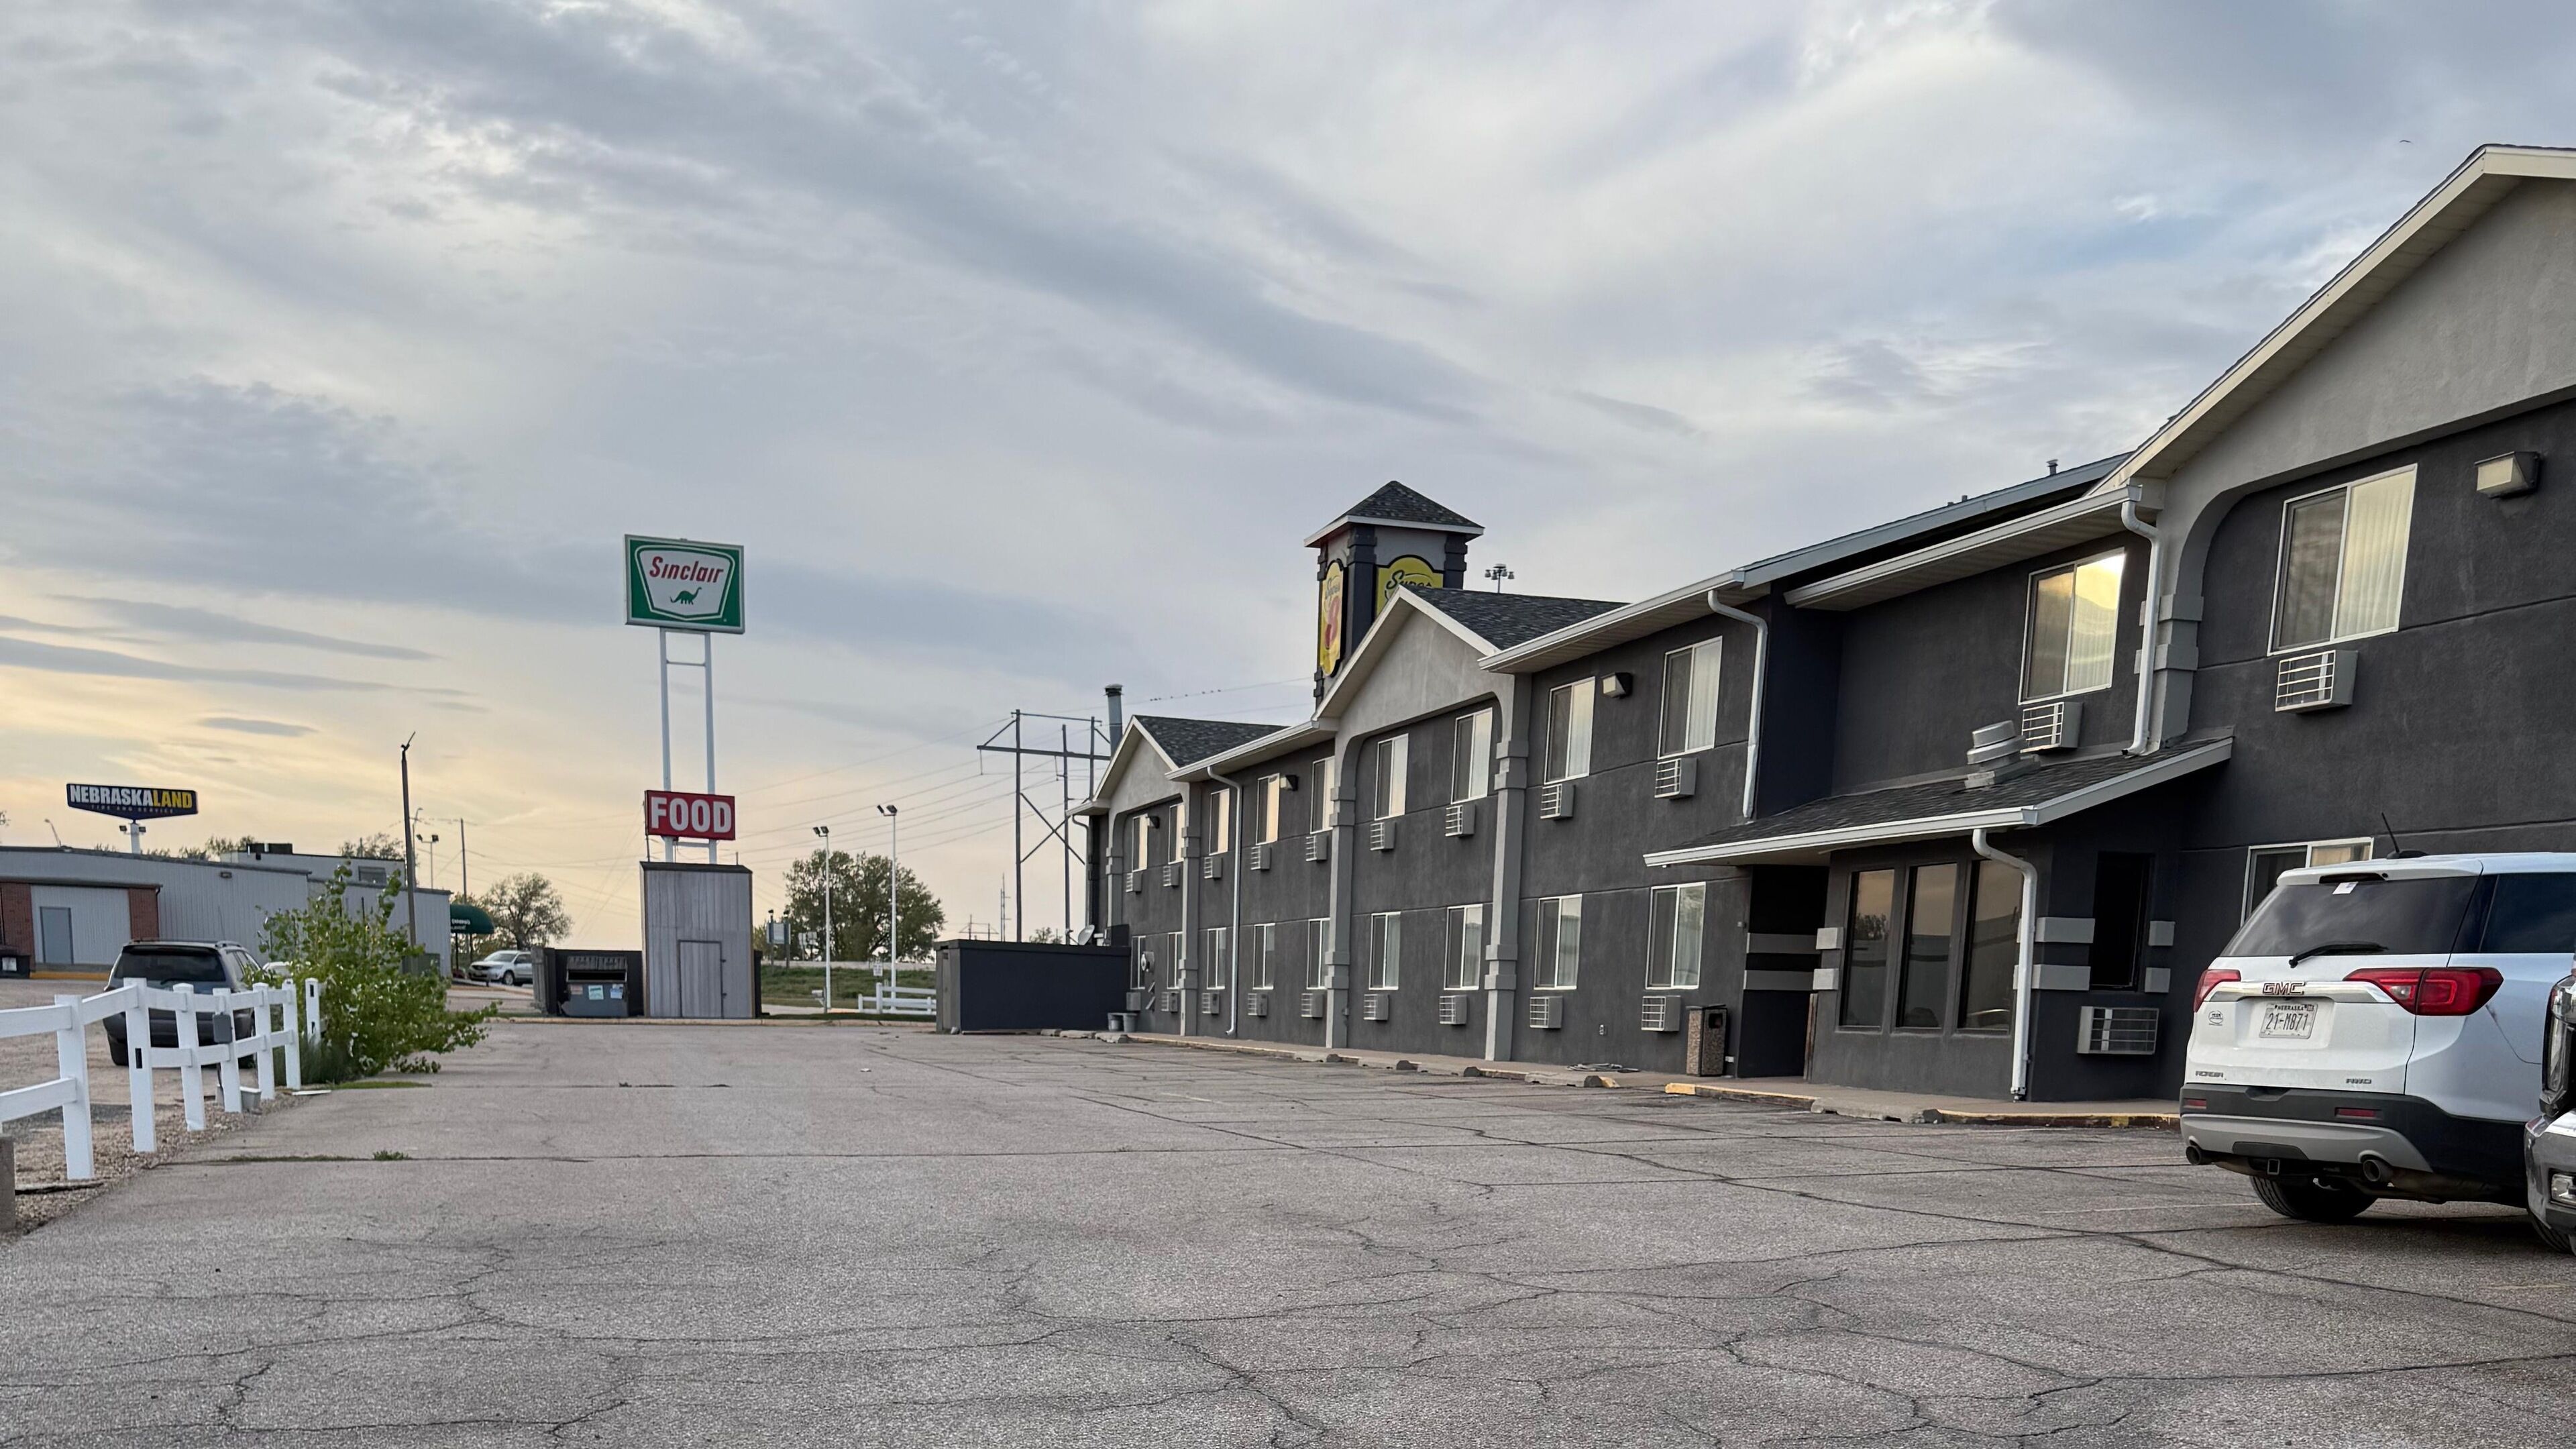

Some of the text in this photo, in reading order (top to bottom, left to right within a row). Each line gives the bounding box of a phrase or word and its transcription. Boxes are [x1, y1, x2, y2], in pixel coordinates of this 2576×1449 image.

[649, 556, 724, 583] Sinclair
[70, 784, 193, 808] NEBRASKALAND
[651, 796, 732, 833] FOOD
[2263, 981, 2306, 996] GMC
[2265, 1012, 2309, 1031] 21-M871
